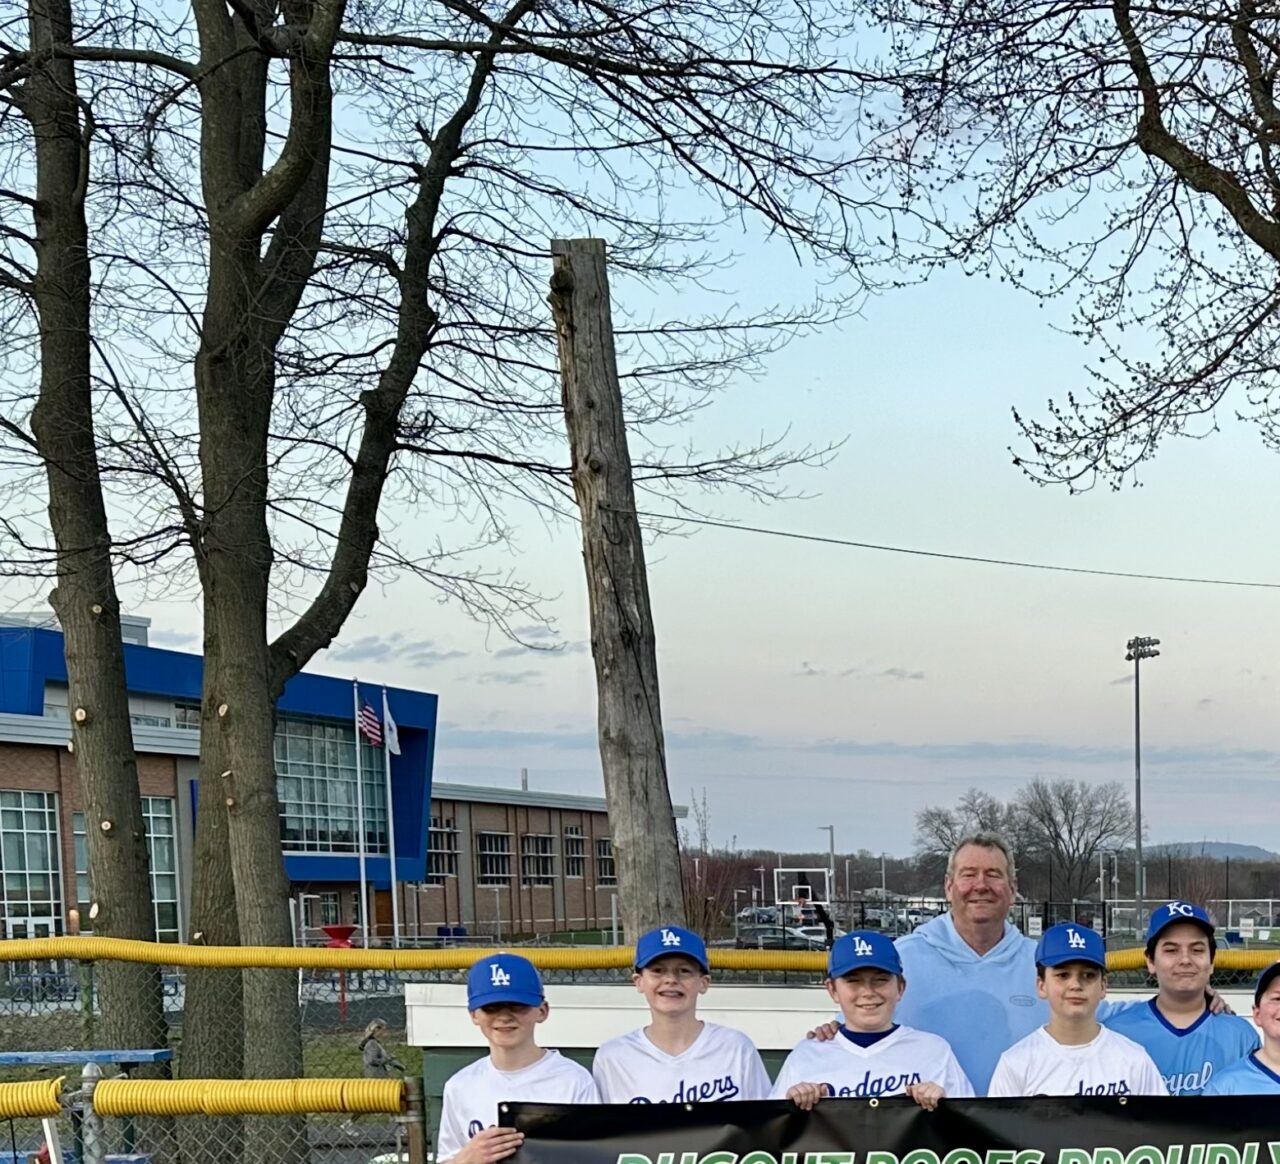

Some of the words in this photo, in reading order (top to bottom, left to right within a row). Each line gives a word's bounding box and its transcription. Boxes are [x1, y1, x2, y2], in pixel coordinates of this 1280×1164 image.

[1167, 901, 1194, 917] KC
[660, 928, 681, 947] LA
[852, 936, 873, 957] LA
[1066, 928, 1086, 949] LA
[490, 963, 510, 986] LA
